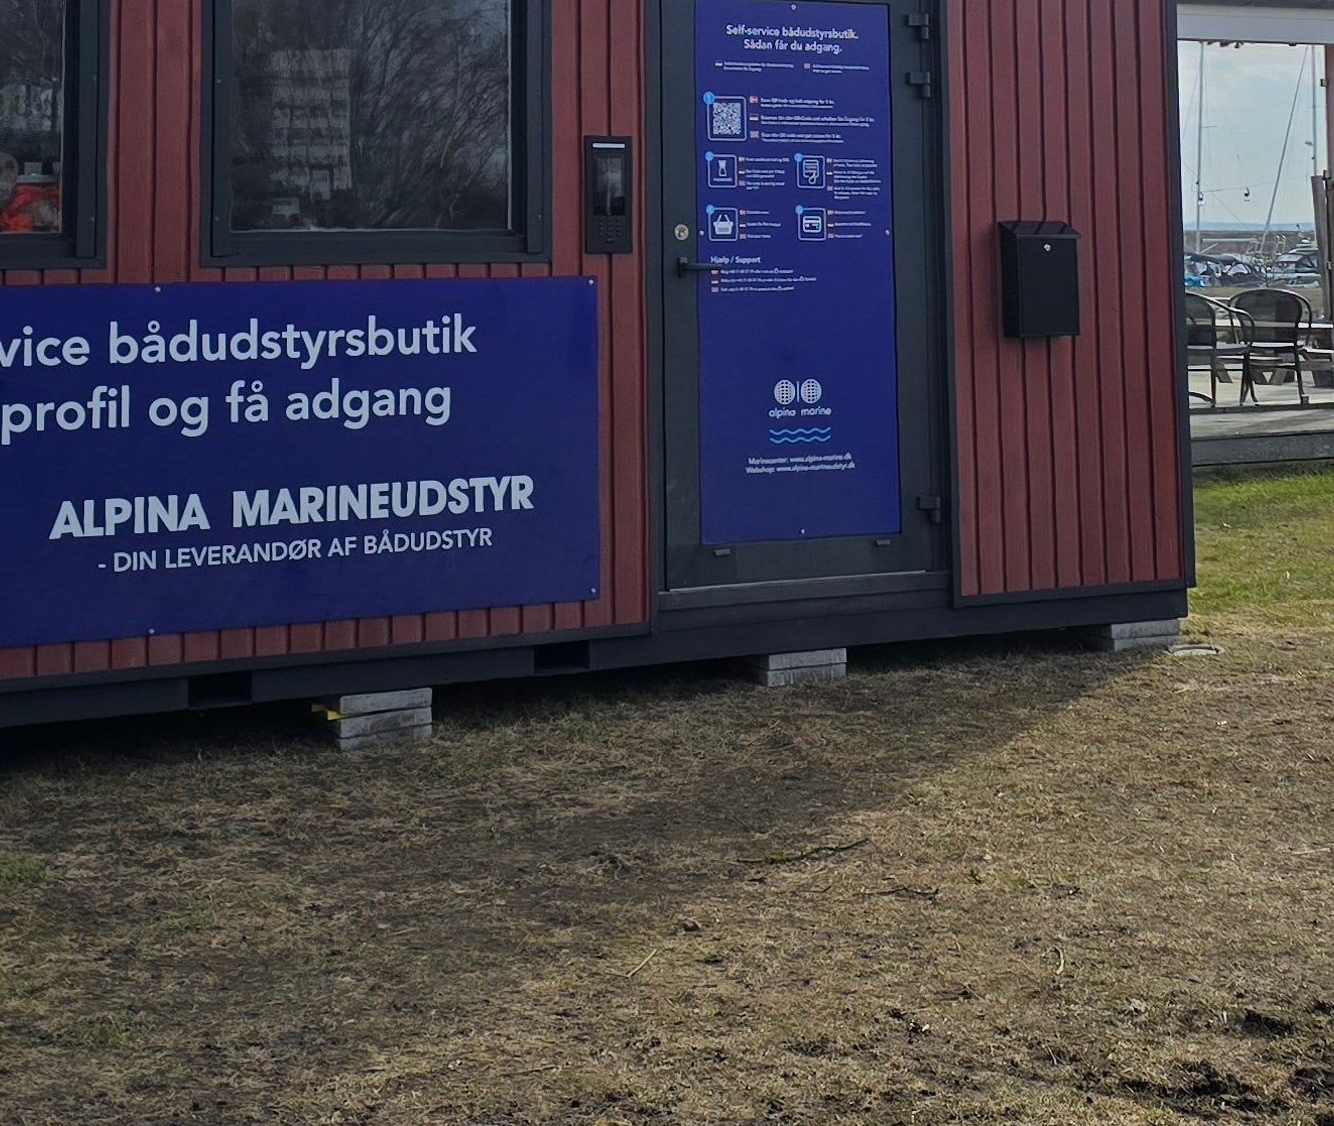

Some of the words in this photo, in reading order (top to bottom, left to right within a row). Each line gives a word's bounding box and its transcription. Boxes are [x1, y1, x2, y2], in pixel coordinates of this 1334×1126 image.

[726, 24, 780, 37] Self-service
[743, 38, 773, 50] Sådan
[775, 39, 788, 51] får
[790, 40, 803, 51] du
[804, 41, 843, 55] adgang.
[109, 312, 478, 370] bådudstyrsbutik
[1, 384, 130, 445] profil
[148, 397, 209, 438] og
[225, 379, 269, 423] få
[285, 377, 451, 430] adgang
[768, 406, 797, 419] alpina
[800, 405, 832, 416] marine
[48, 494, 211, 540] ALPINA
[232, 474, 535, 528] MARINEUDSTYR
[113, 549, 157, 573] DIN
[165, 538, 322, 569] LEVERANDØR
[327, 536, 357, 558] AF
[363, 527, 493, 555] BÅDUDSTYR
